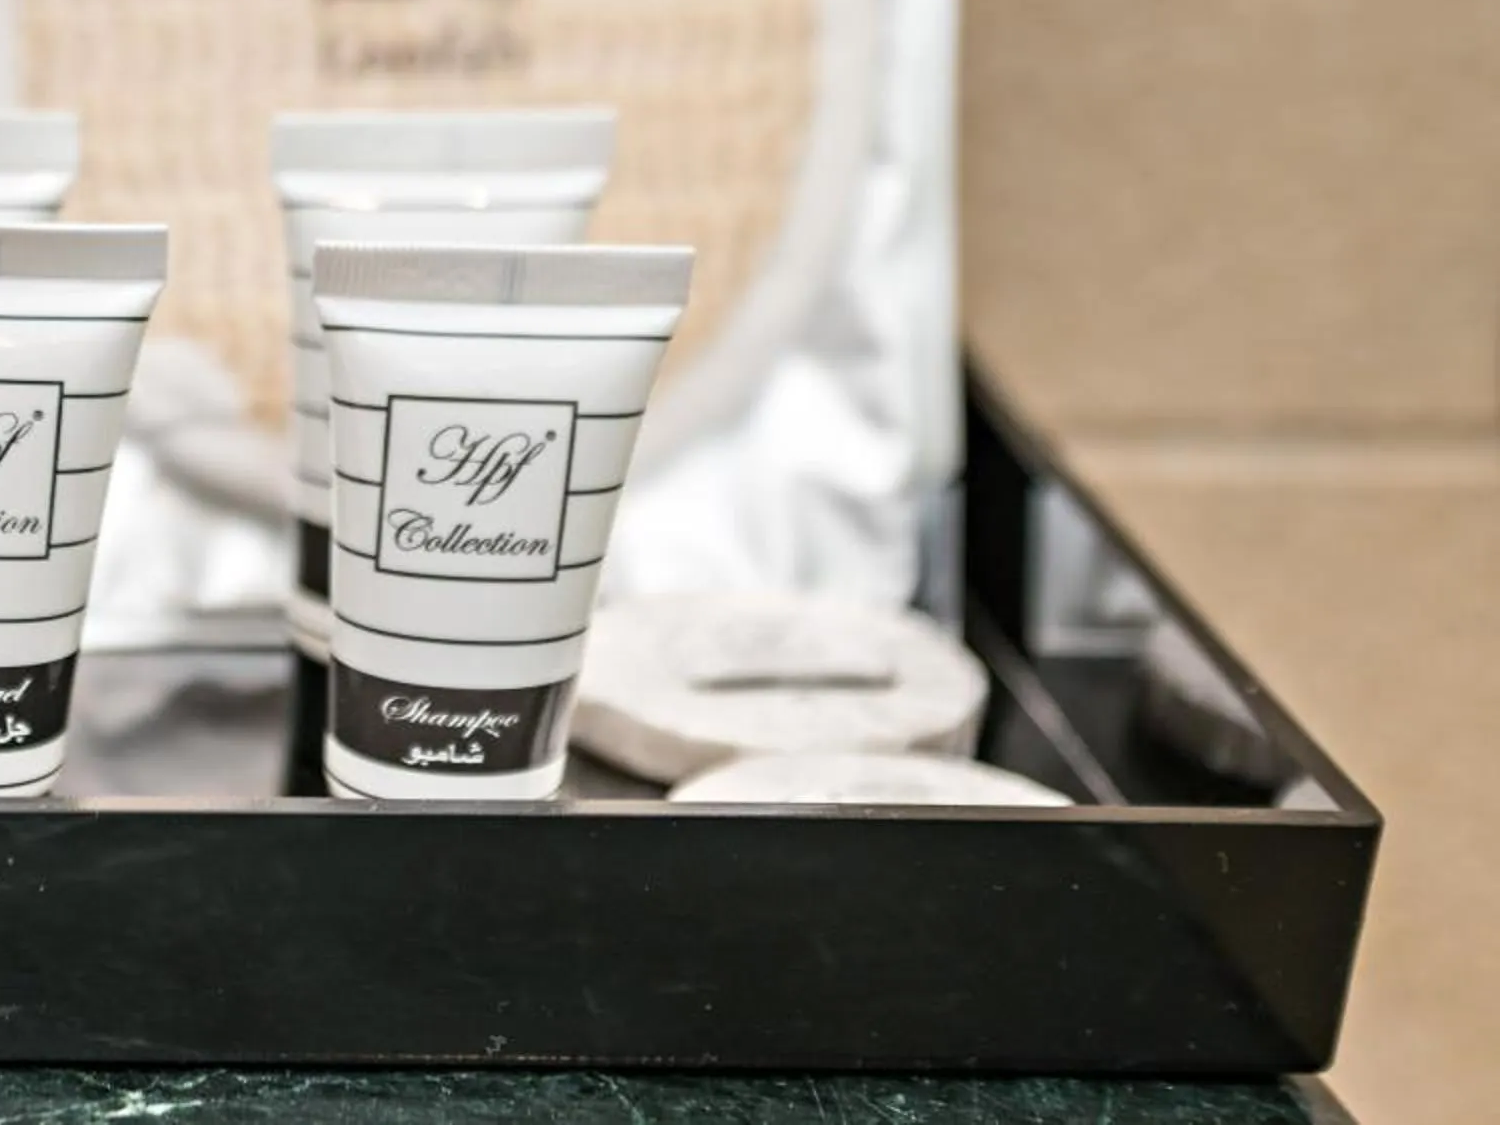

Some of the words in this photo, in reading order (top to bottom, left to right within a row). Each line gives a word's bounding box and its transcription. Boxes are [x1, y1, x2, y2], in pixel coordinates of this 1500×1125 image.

[387, 508, 552, 557] Collection
[381, 696, 520, 739] Shampoo
[402, 742, 485, 767] شامبو
